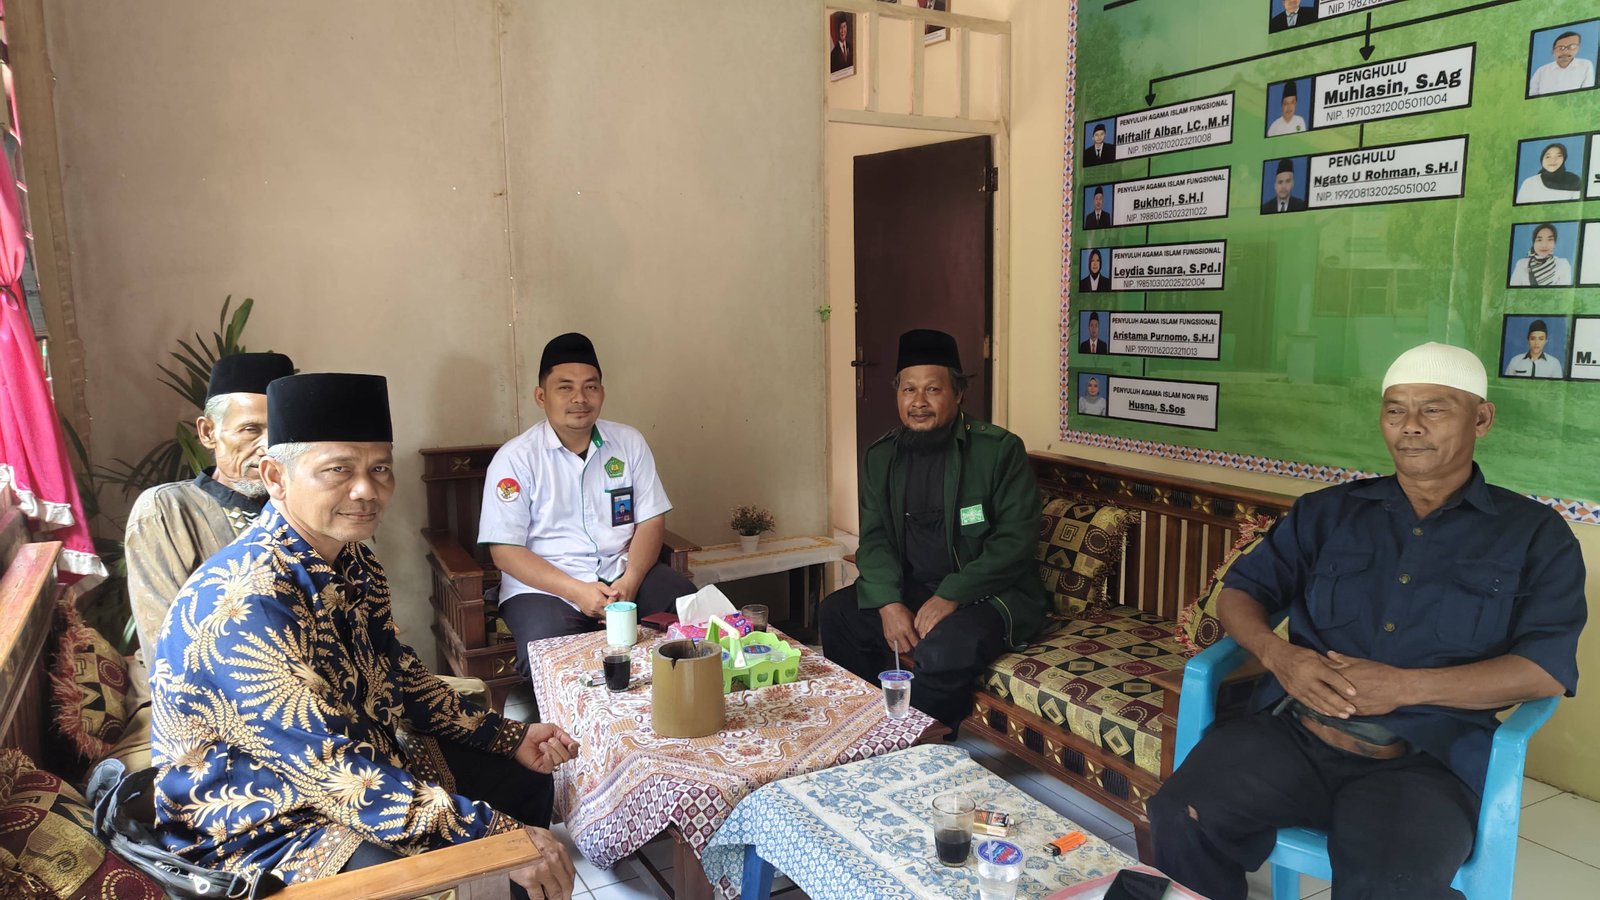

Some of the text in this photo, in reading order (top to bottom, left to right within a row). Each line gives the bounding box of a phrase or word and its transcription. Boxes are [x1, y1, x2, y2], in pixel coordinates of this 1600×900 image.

[1328, 3, 1345, 14] NIP.
[1338, 61, 1407, 85] PENGHULU
[1324, 68, 1462, 105] Muhlasin, S.Ag
[1120, 99, 1228, 126] PENYULUH AGAMA ISLAM FUNGSIONAL
[1326, 94, 1447, 121] NIP. 197103212005011004
[1117, 130, 1151, 144] Miftalif
[1154, 124, 1183, 138] Albar,
[1128, 147, 1140, 155] NIP.
[1329, 150, 1395, 168] PENGHULU
[1314, 161, 1458, 187] Ngato U Rohman, S.H.I
[1118, 183, 1144, 193] PENYULUH
[1146, 181, 1166, 190] AGAMA
[1186, 174, 1225, 185] FUNGSIONAL
[1317, 182, 1436, 201] NIP. 199208132025051002
[1134, 192, 1204, 209] Bukhori, S.H.I
[1126, 214, 1138, 222] NIP.
[1183, 247, 1221, 255] FUNGSIONAL
[1114, 263, 1221, 278] Leydia Sunara, S.Pd.I
[1113, 331, 1214, 342] Aristama Purnomo, S.H.I
[1576, 352, 1596, 363] M.
[1113, 386, 1140, 394] PENYULUH
[1129, 400, 1185, 414] Husna, S.Sos
